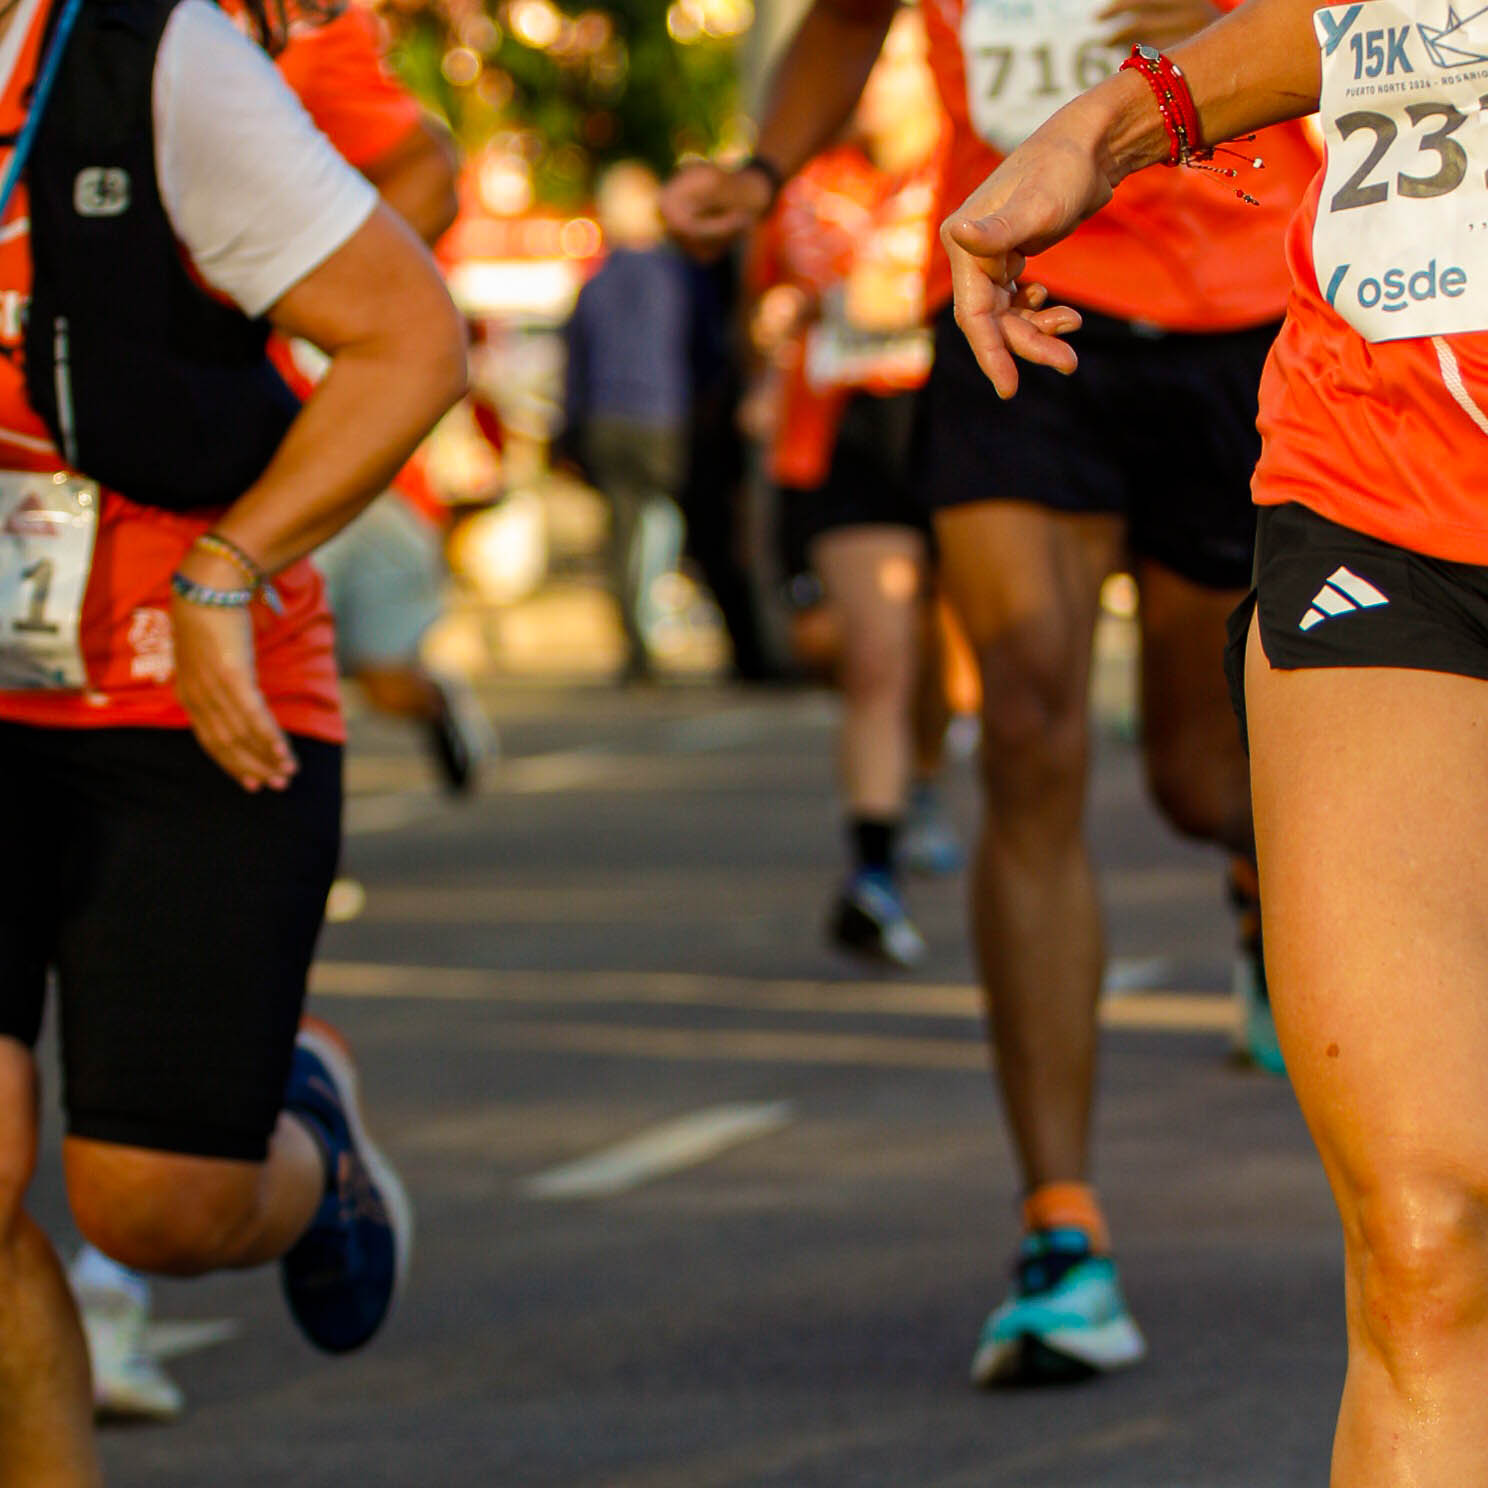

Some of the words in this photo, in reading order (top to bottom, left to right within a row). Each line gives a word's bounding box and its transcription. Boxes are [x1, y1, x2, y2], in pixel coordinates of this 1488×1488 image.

[1350, 25, 1414, 80] 15K
[1345, 85, 1375, 97] PUERTO
[1378, 82, 1406, 94] NORTE
[1441, 70, 1488, 86] ROSARIO
[1357, 258, 1468, 311] osde
